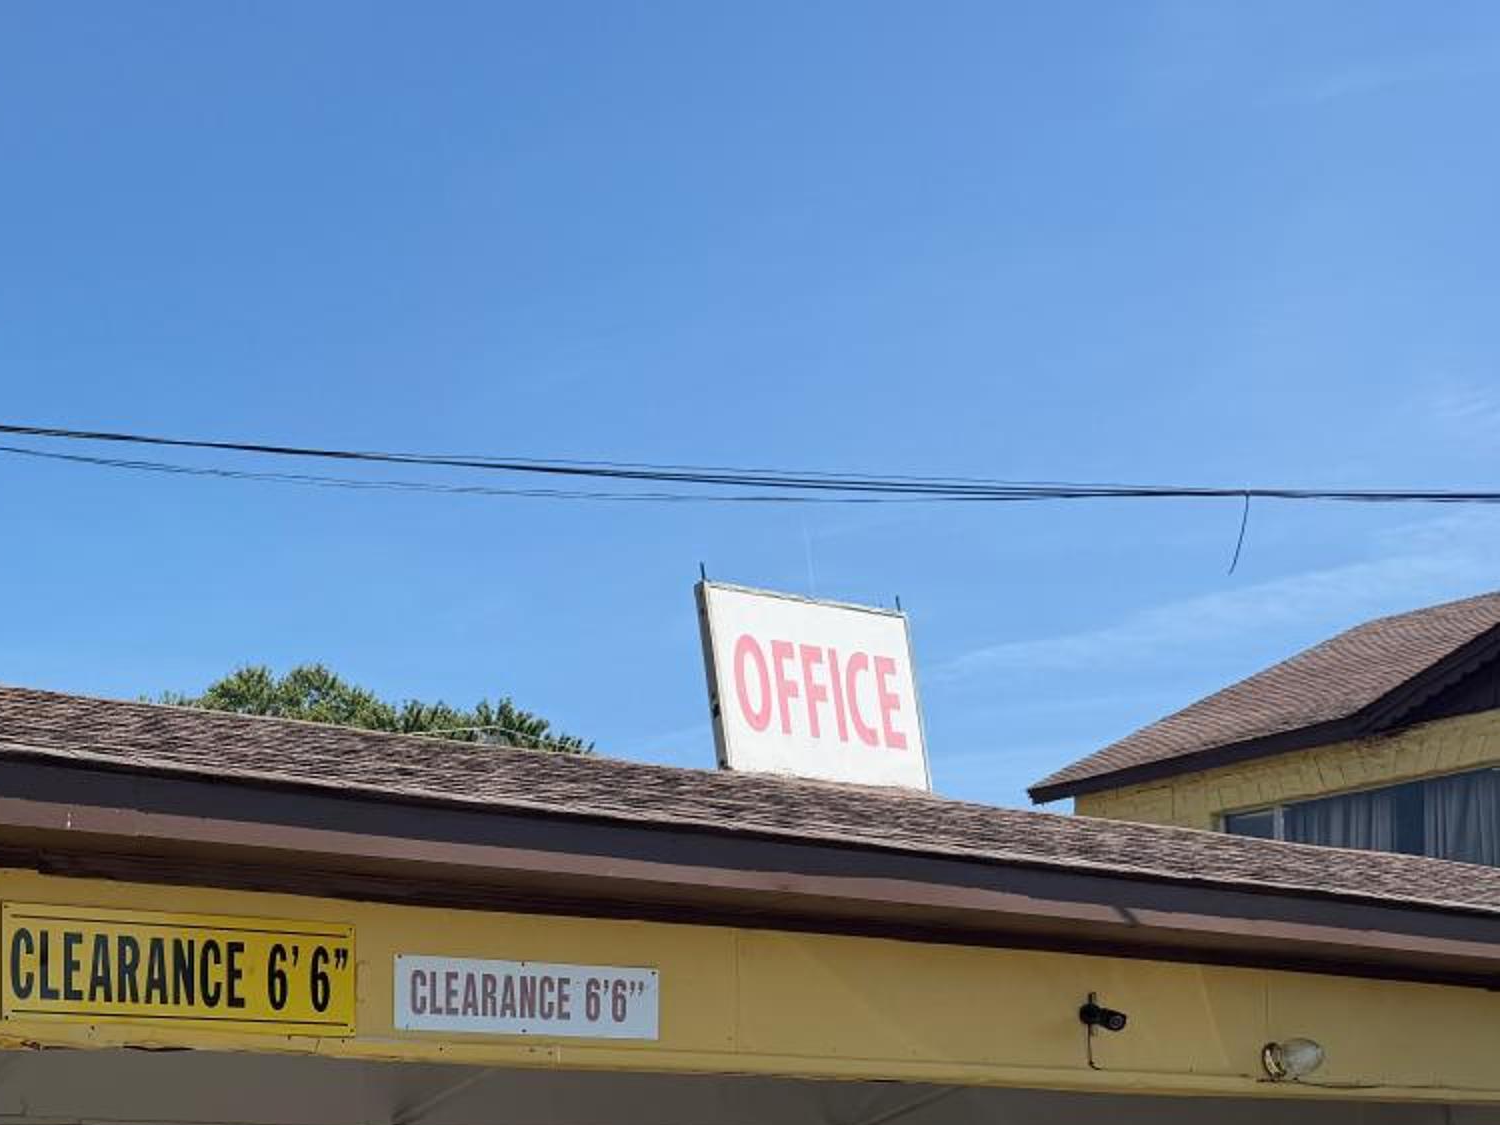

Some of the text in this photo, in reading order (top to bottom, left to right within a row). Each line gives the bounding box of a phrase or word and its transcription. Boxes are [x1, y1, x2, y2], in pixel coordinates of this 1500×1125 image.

[734, 633, 908, 751] OFFICE
[10, 927, 245, 1009] CLEARANCE
[410, 969, 571, 1021] CLEARANCE
